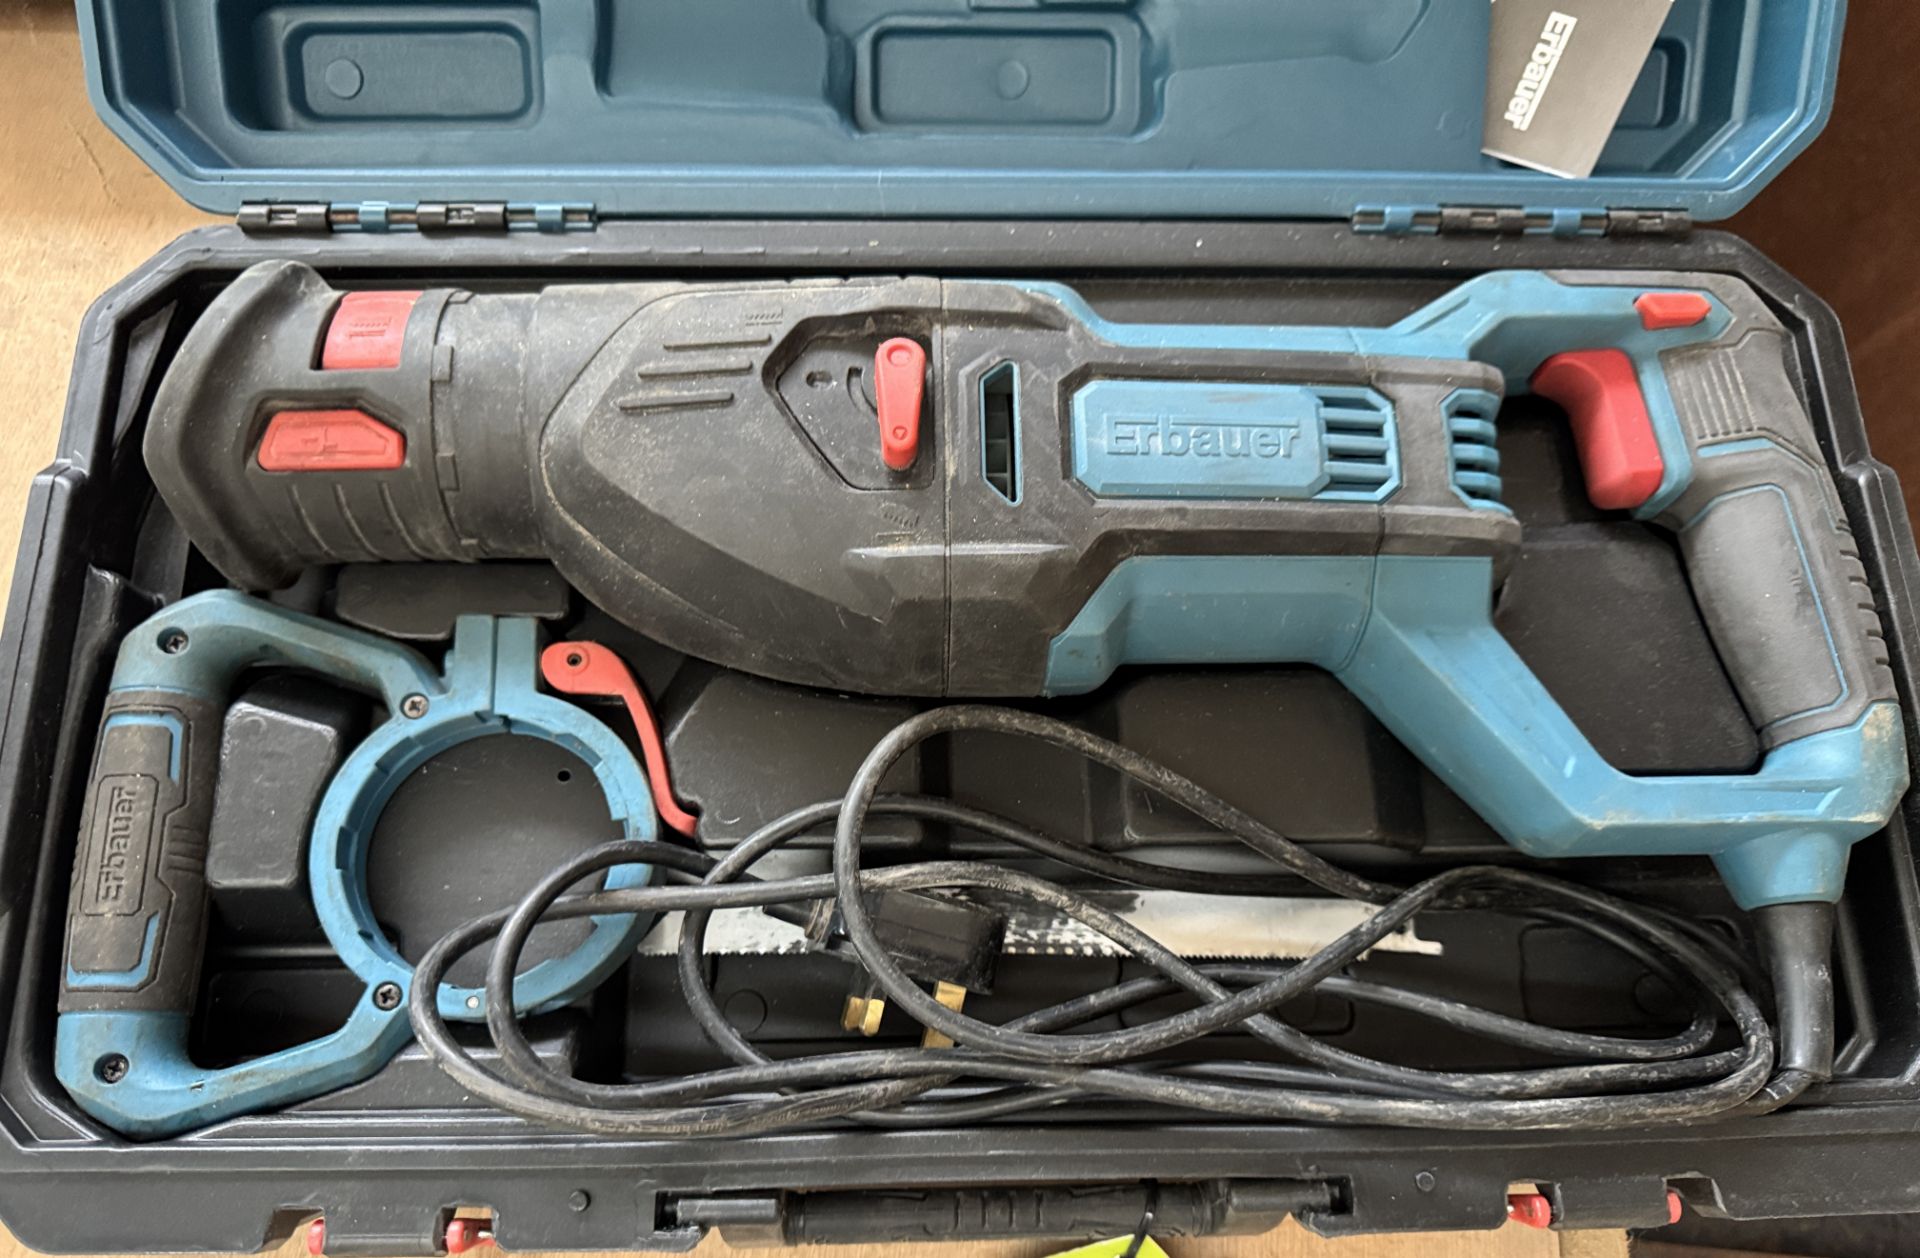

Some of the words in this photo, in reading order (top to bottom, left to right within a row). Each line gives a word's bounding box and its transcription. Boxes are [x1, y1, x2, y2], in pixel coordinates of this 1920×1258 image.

[1504, 11, 1577, 131] Erbauer
[1105, 413, 1300, 458] Erbauer
[96, 786, 137, 902] Erbauer
